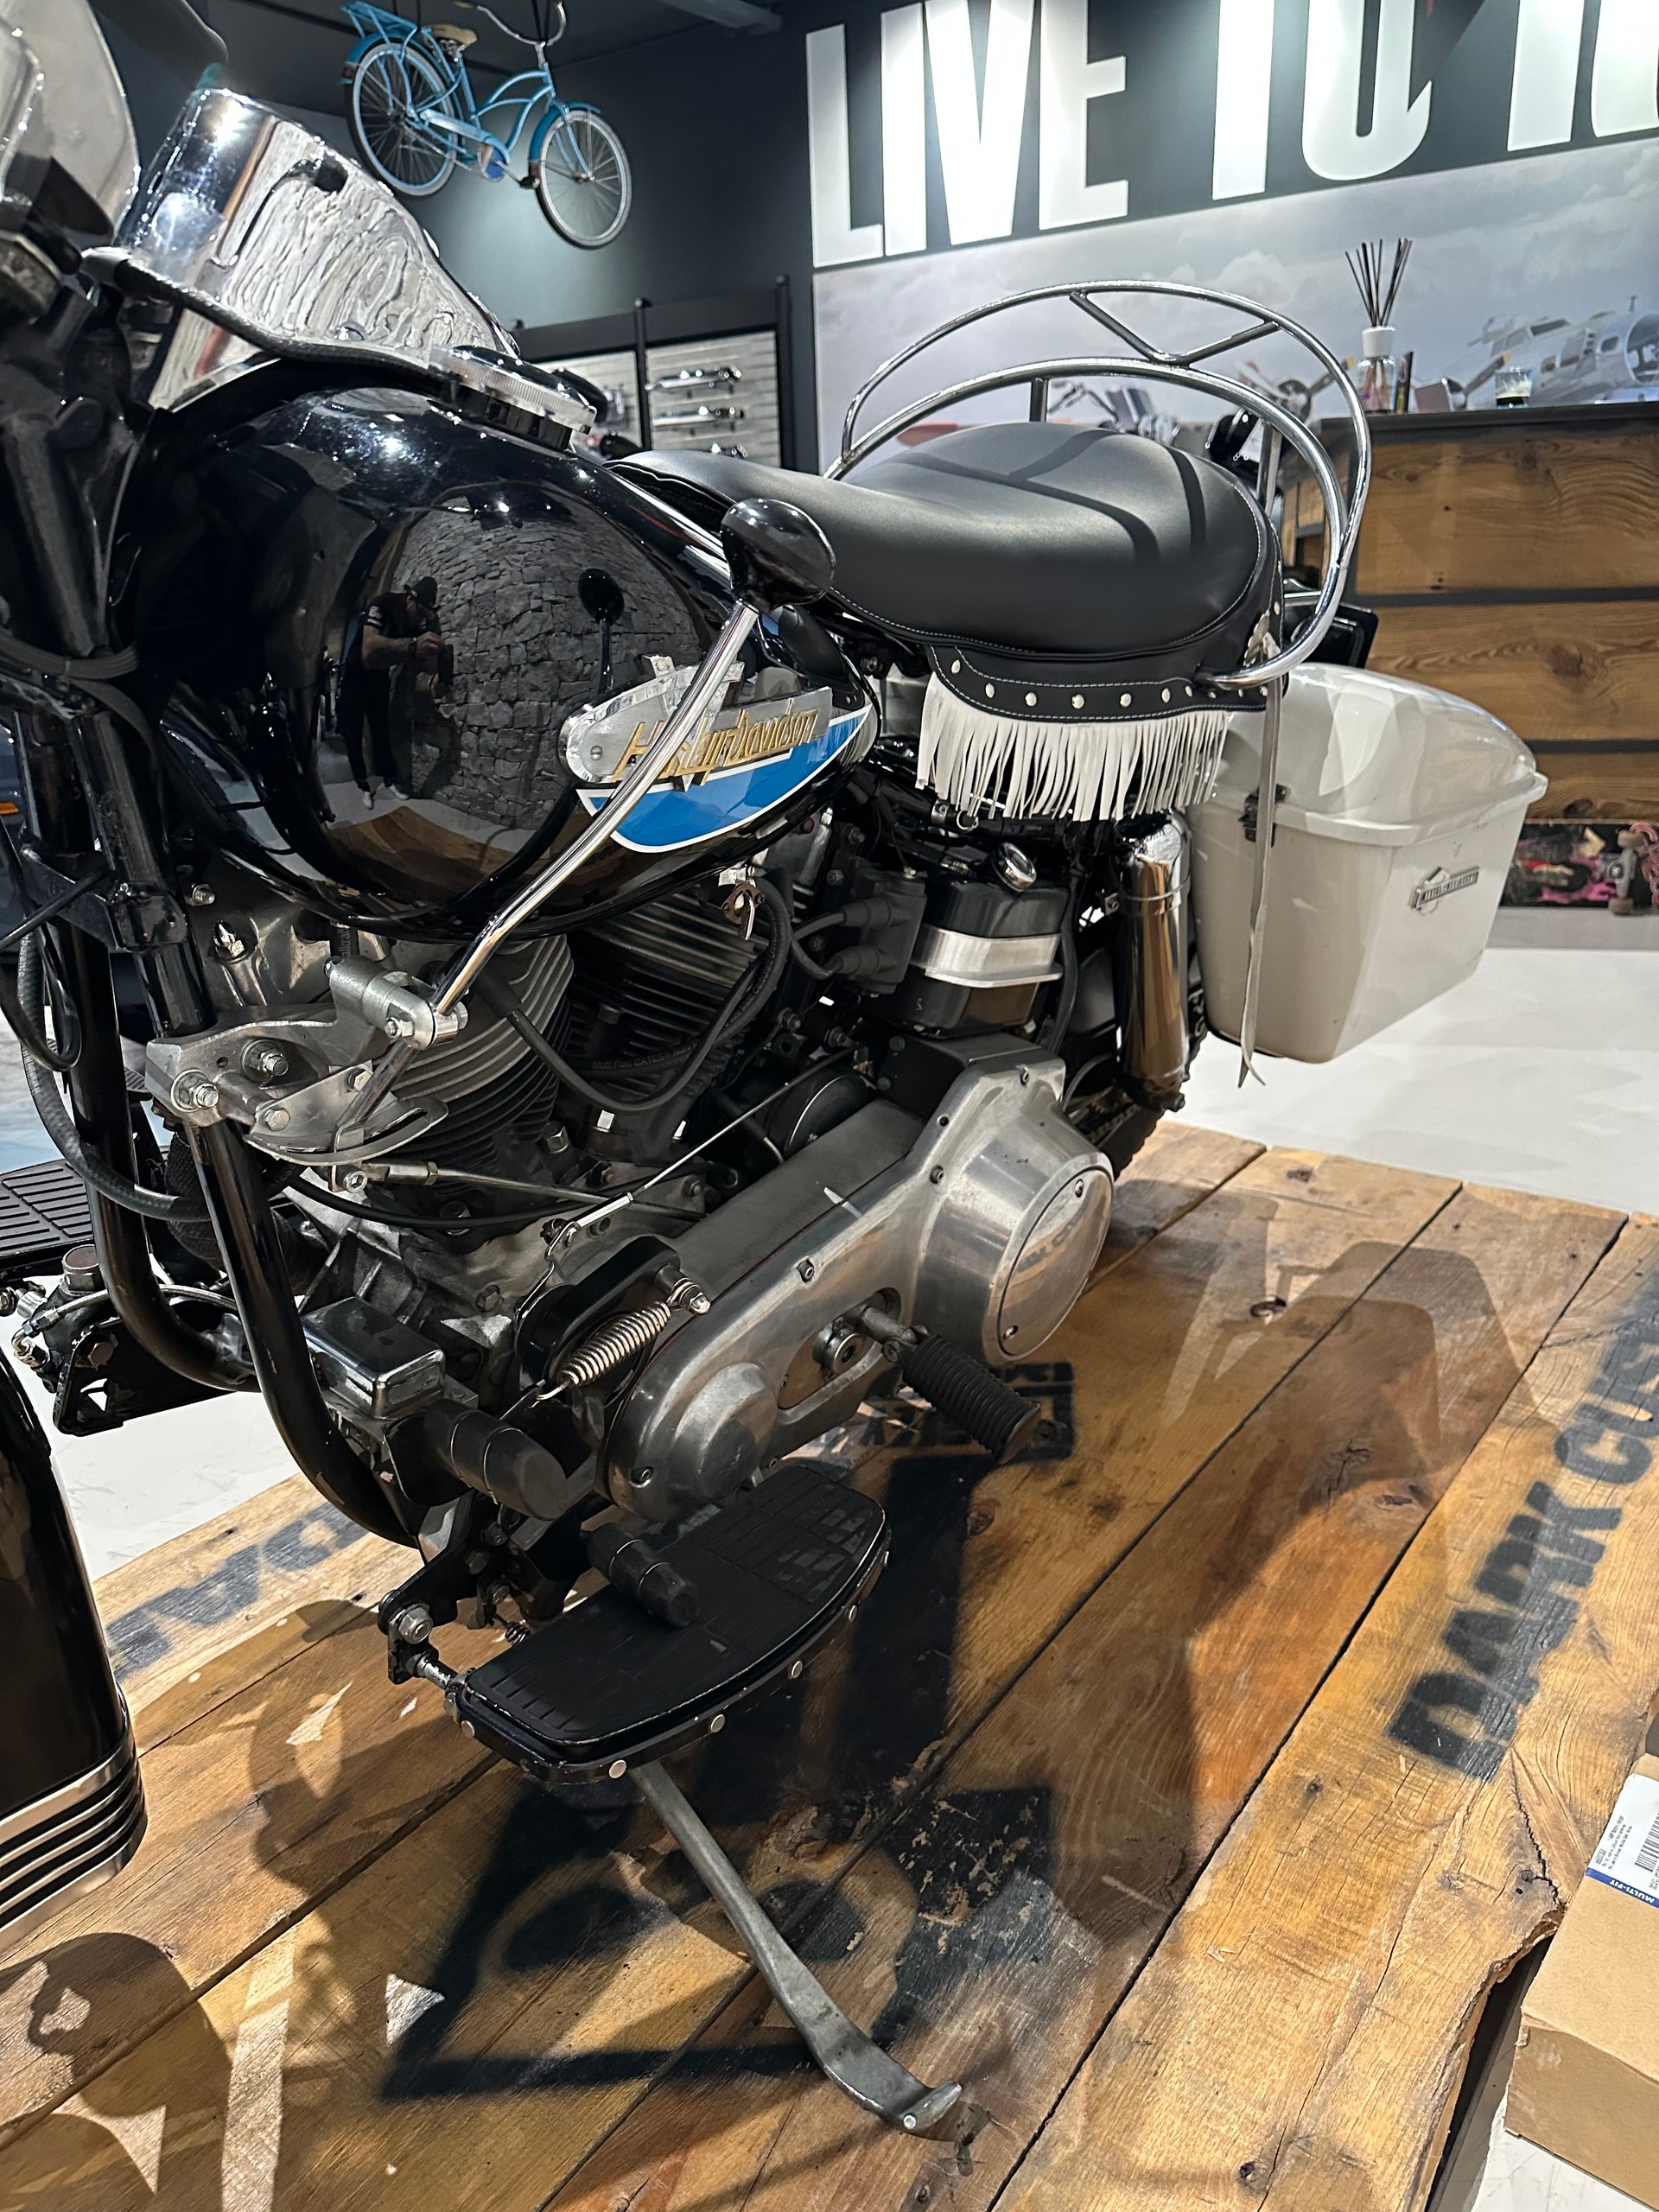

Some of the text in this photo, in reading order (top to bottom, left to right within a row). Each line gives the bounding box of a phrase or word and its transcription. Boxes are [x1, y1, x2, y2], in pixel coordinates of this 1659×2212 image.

[805, 0, 1128, 268] LIVE
[633, 1053, 665, 1066] GATES
[1388, 1480, 1623, 1783] DARK
[1608, 1878, 1656, 1904] MULTI-FIT
